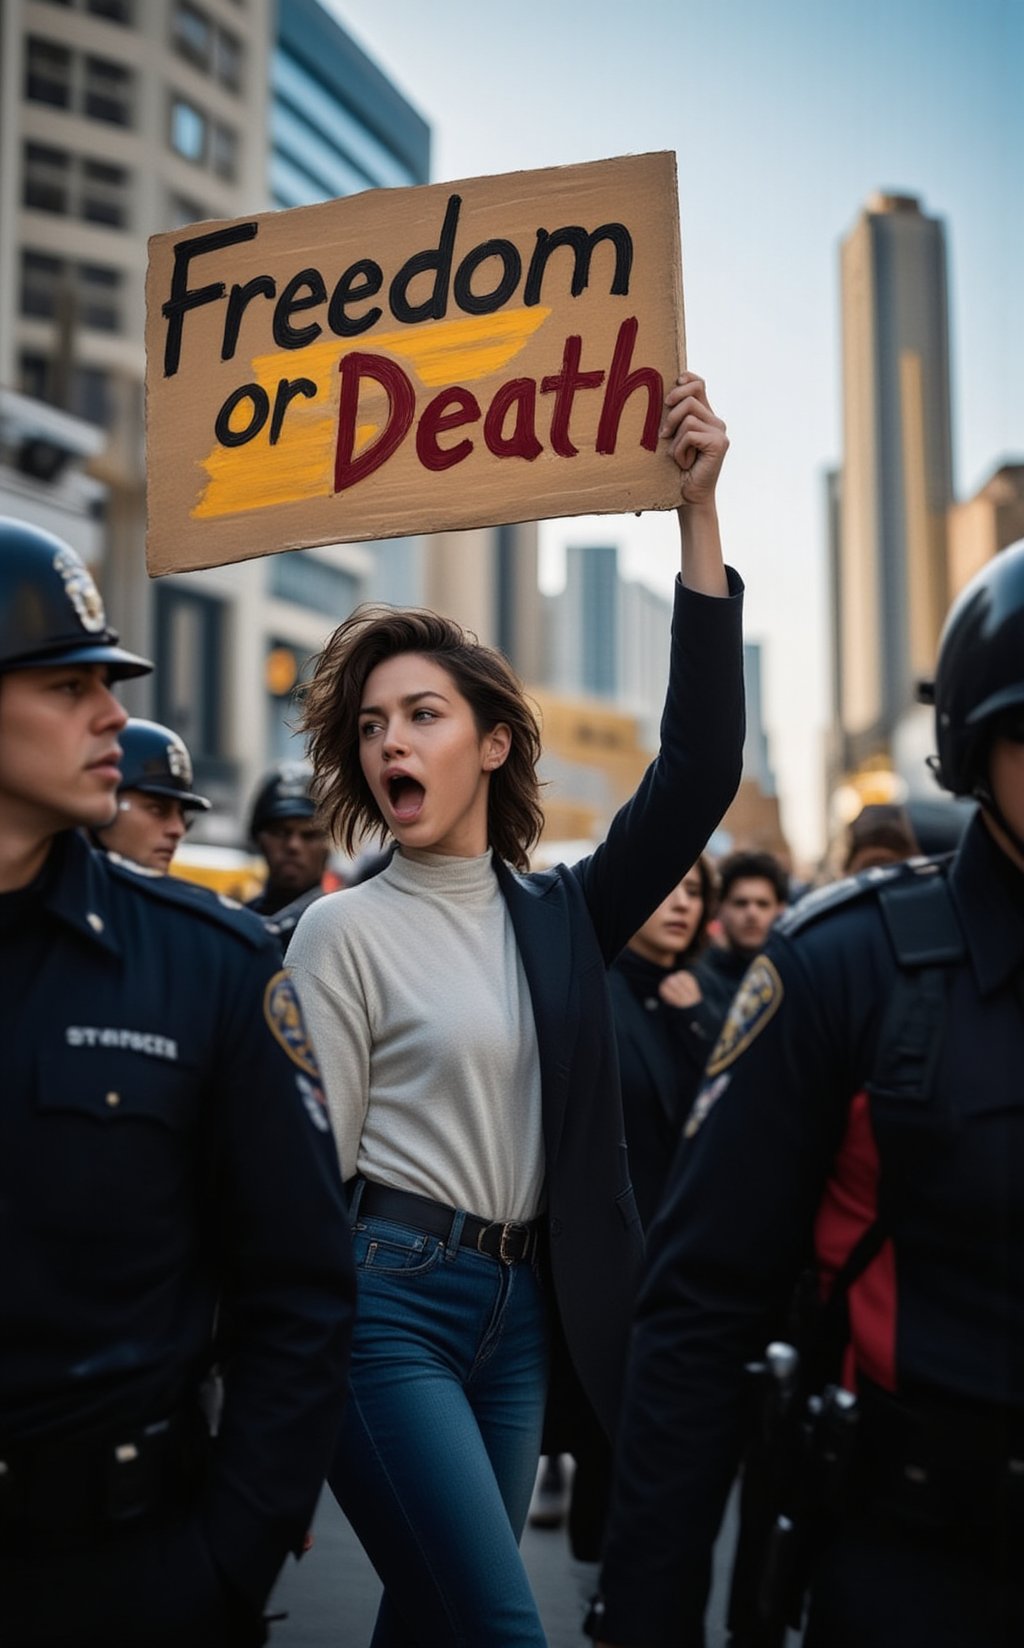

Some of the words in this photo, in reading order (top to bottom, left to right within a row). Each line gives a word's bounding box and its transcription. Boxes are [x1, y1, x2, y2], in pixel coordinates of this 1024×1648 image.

[161, 194, 634, 378] Freedom
[214, 377, 318, 448] or
[333, 315, 665, 494] Death
